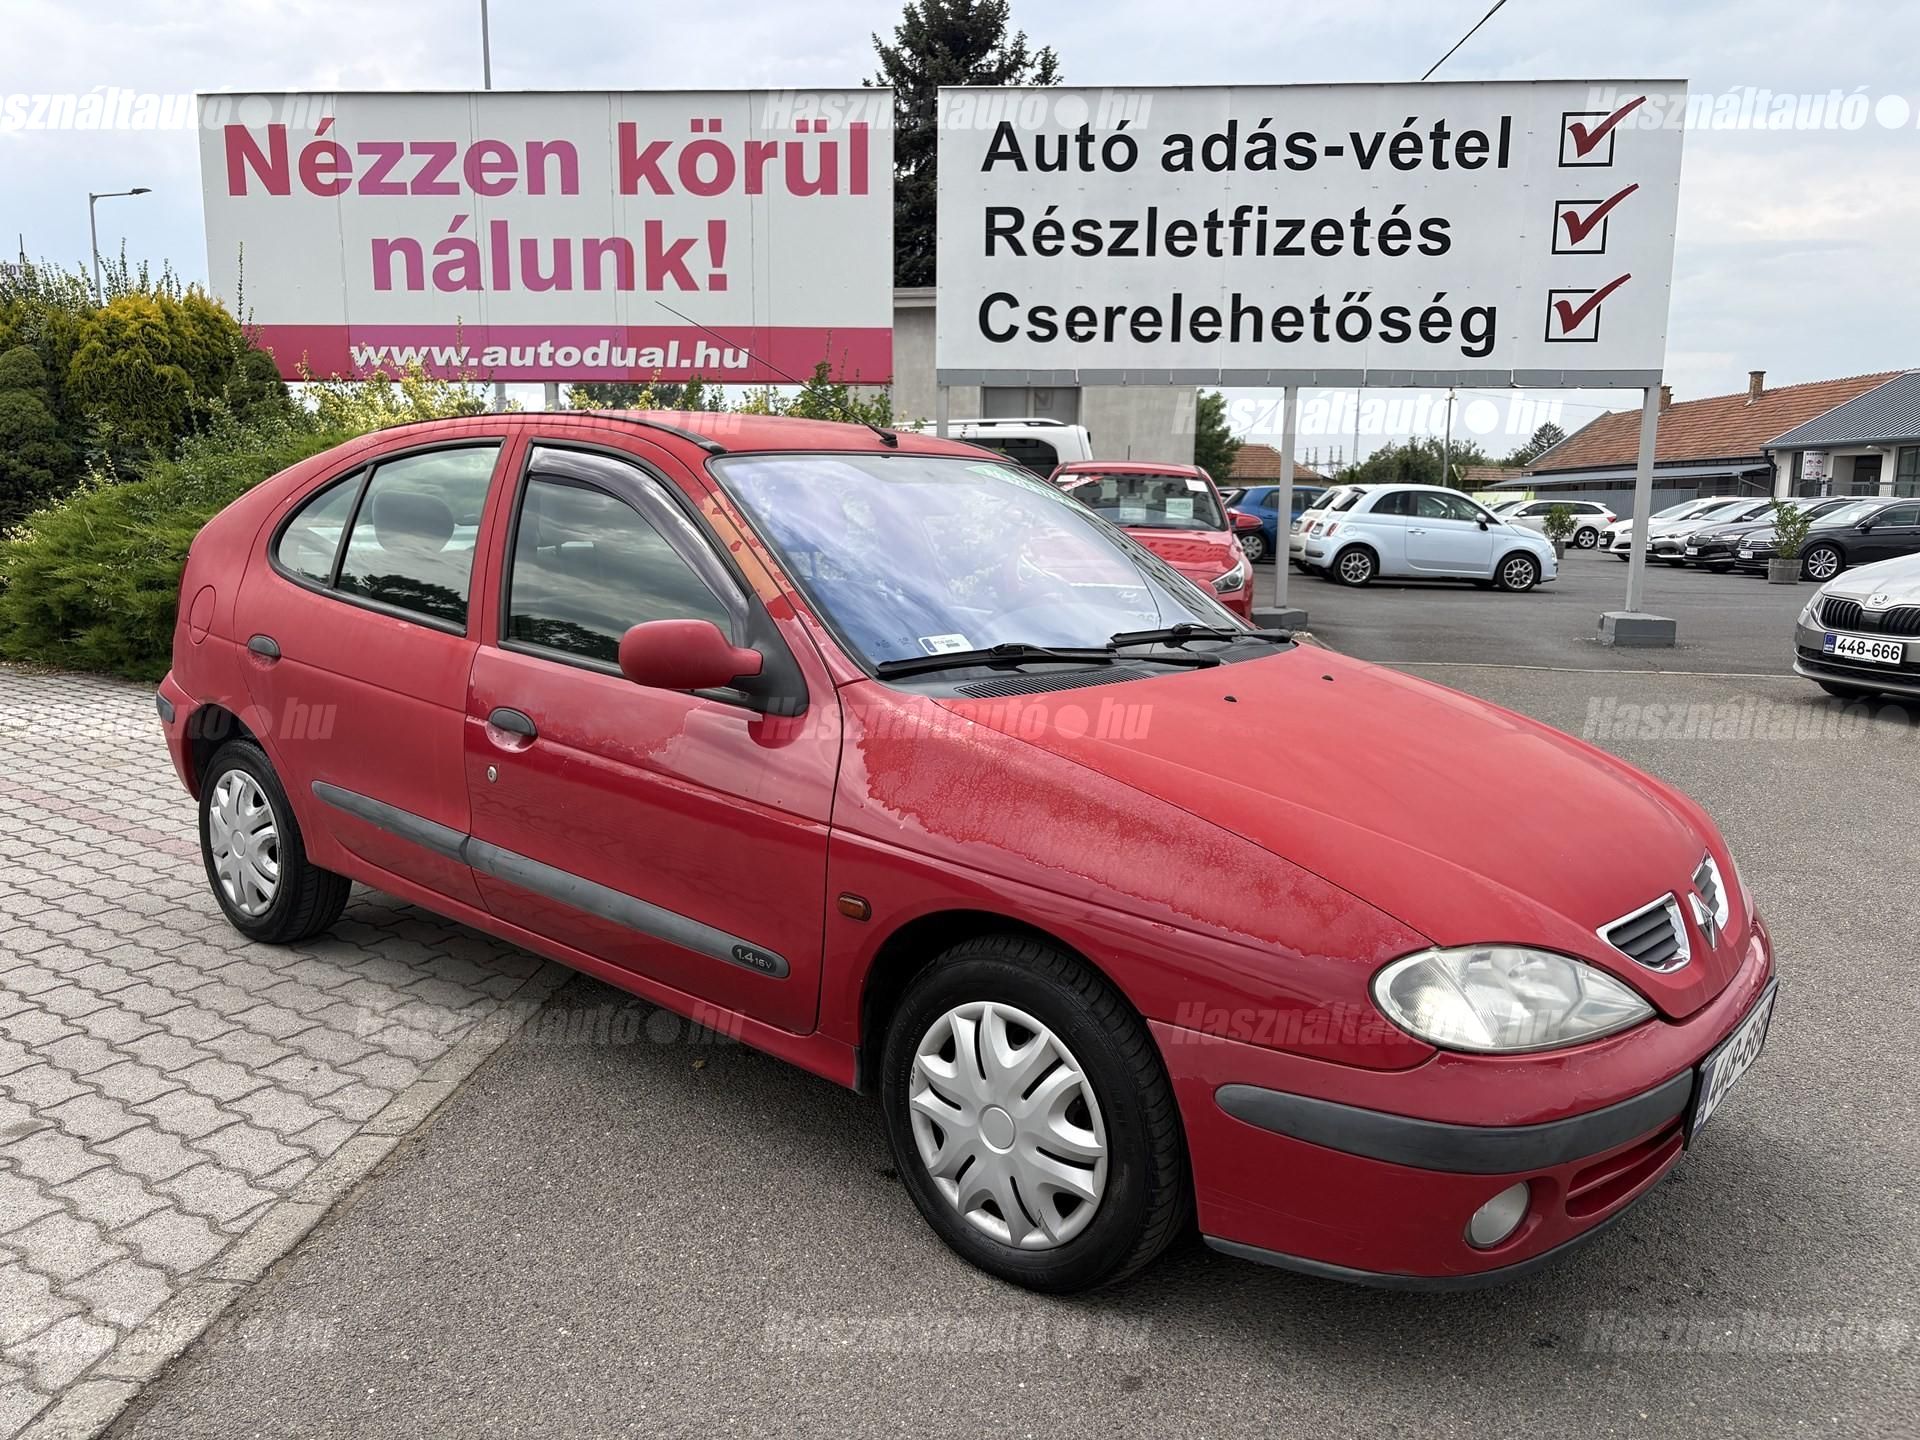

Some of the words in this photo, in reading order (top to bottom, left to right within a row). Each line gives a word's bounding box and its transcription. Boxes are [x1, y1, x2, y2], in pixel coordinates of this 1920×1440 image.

[224, 118, 579, 196] Nézzen
[619, 118, 869, 196] körül
[981, 119, 1139, 173] Autó
[1161, 116, 1512, 172] adás-vétel
[371, 215, 728, 292] nálunk!
[985, 204, 1452, 258] Részletfizetés
[978, 291, 1497, 358] Cserelehetőség
[351, 340, 749, 368] www.autodual.hu
[1837, 638, 1901, 661] 448-666
